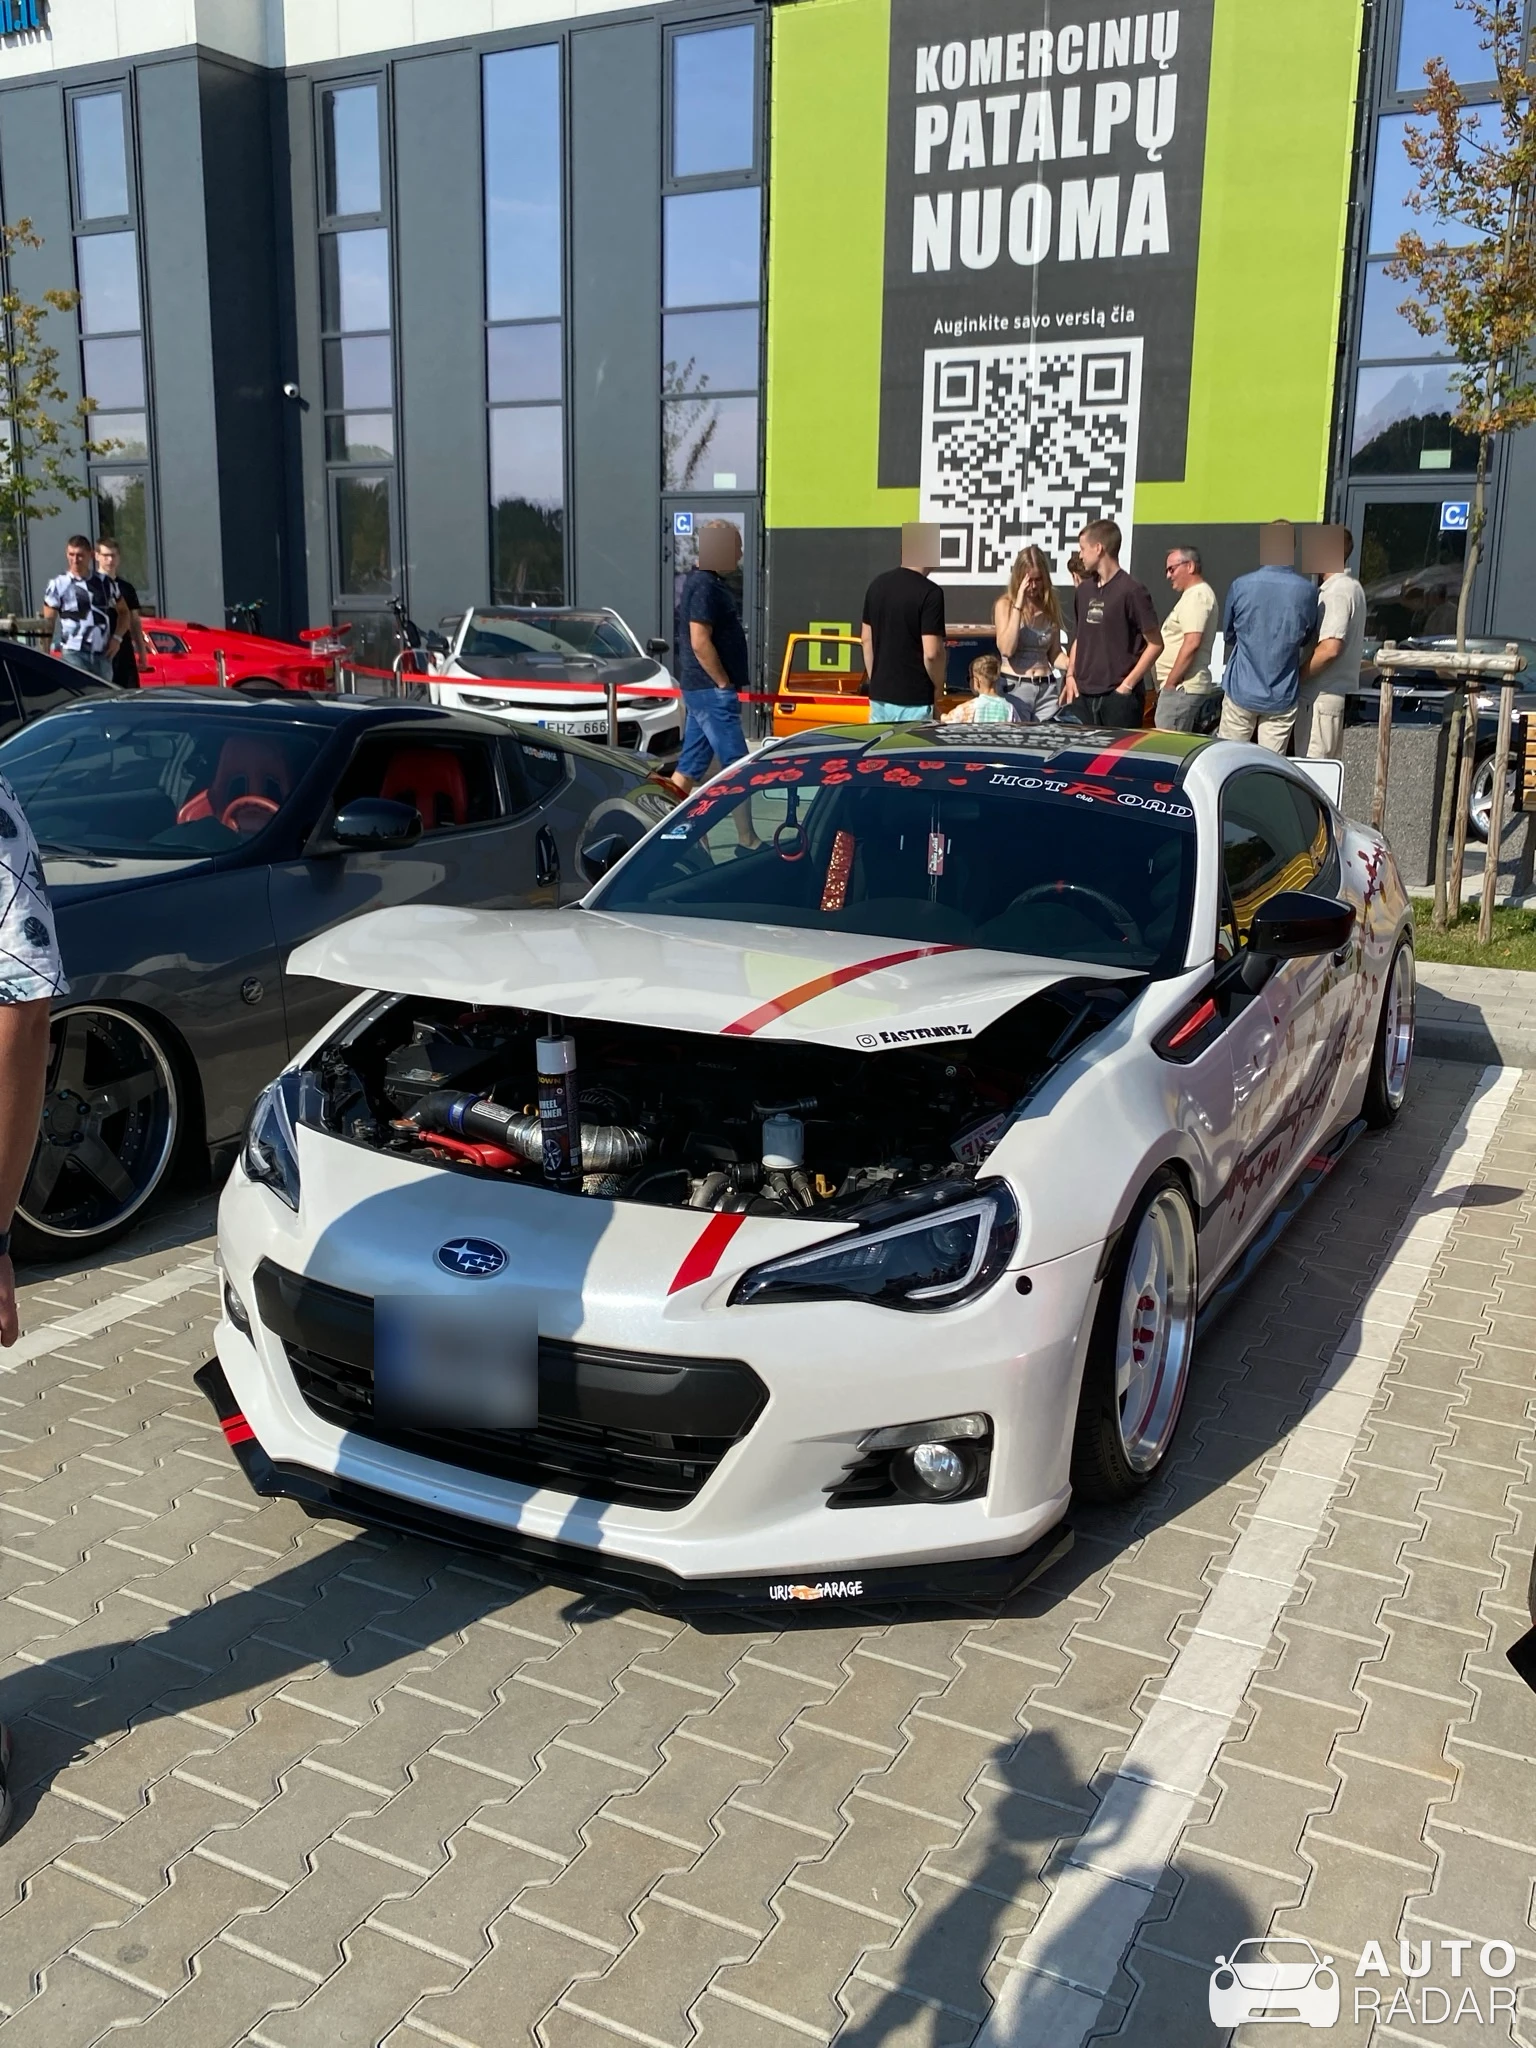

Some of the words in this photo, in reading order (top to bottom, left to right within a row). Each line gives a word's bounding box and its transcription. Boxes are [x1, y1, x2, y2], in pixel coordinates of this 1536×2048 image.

[915, 10, 1179, 93] KOMERCINIŲ
[914, 73, 1178, 175] PATALPŲ
[912, 171, 1170, 273] NUOMA
[934, 313, 1009, 337] Auginkite
[1013, 314, 1051, 330] savo
[1056, 306, 1106, 328] verslą
[1110, 303, 1135, 323] čia
[584, 722, 606, 734] 666
[989, 773, 1068, 793] HOT
[1061, 781, 1193, 818] ROAD
[1075, 793, 1094, 803] club
[815, 1581, 864, 1599] GARAGE
